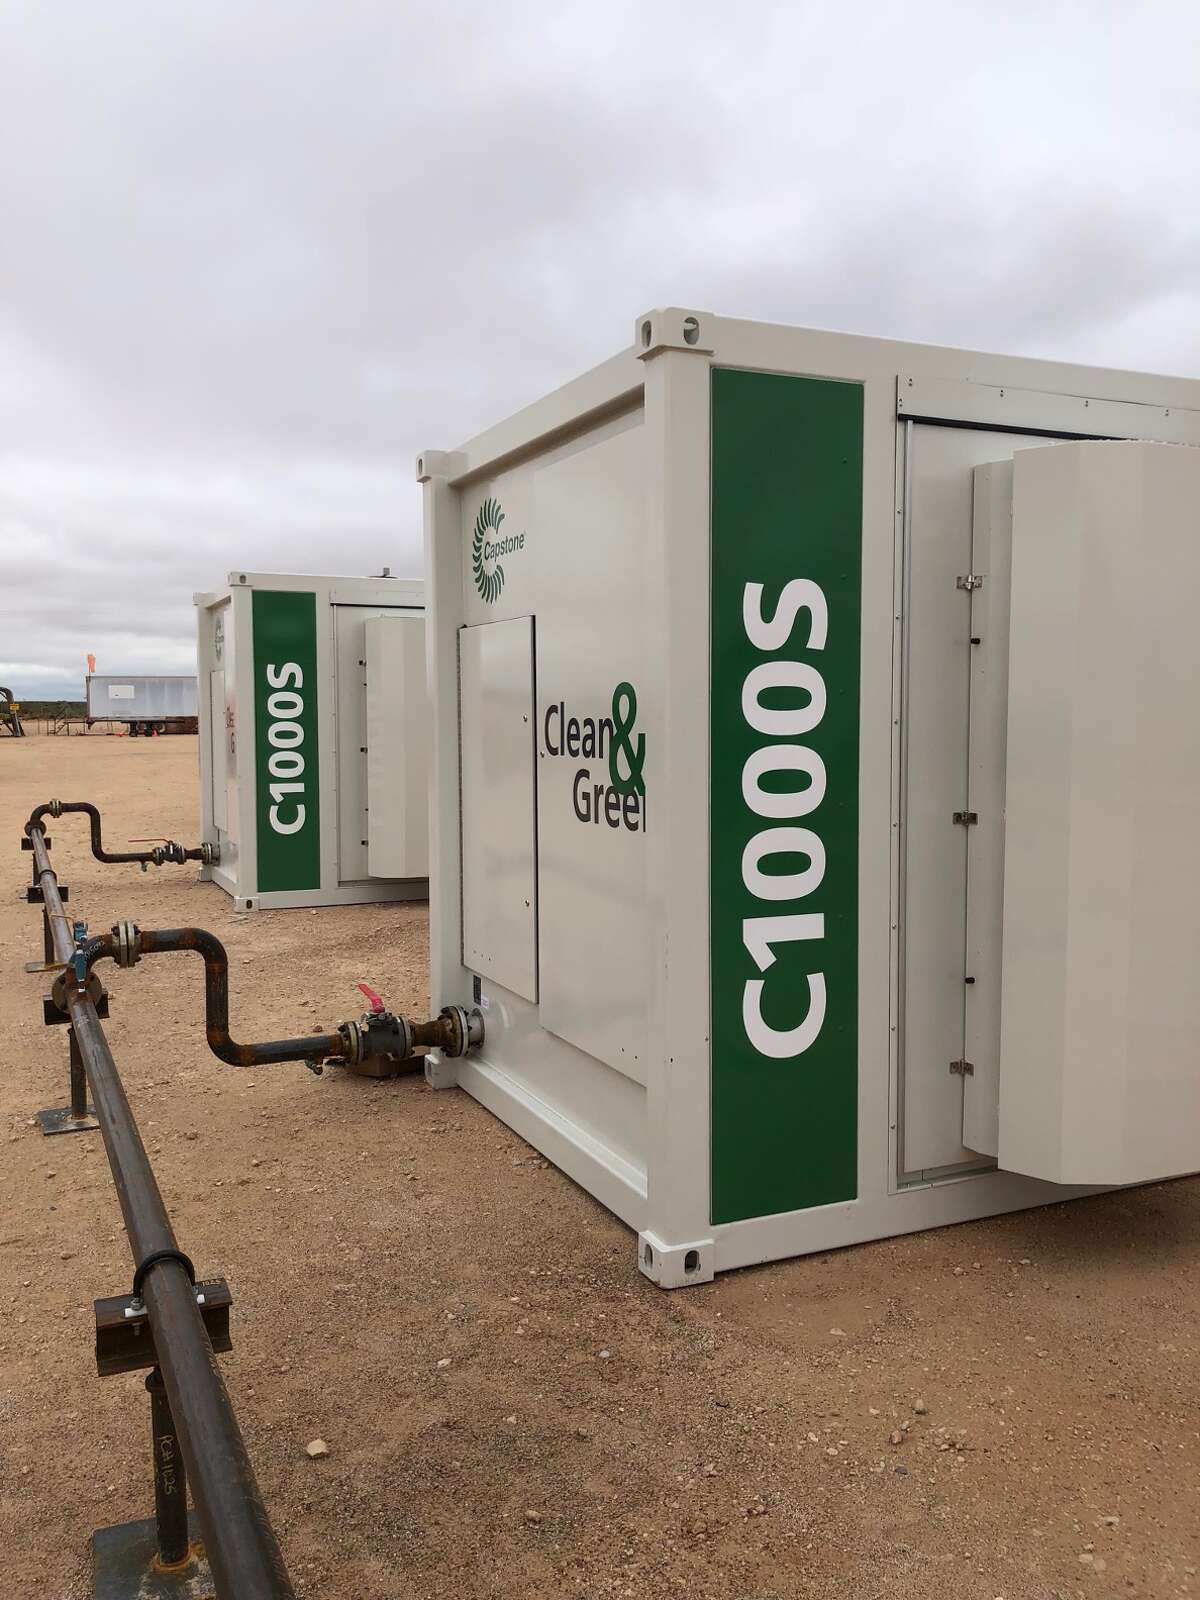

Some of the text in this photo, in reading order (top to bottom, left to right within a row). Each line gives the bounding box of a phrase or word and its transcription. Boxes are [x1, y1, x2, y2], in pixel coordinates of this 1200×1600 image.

[484, 533, 525, 562] Capstone
[266, 662, 306, 835] C1000S
[544, 681, 646, 797] Clean &
[741, 578, 828, 1059] C1000S
